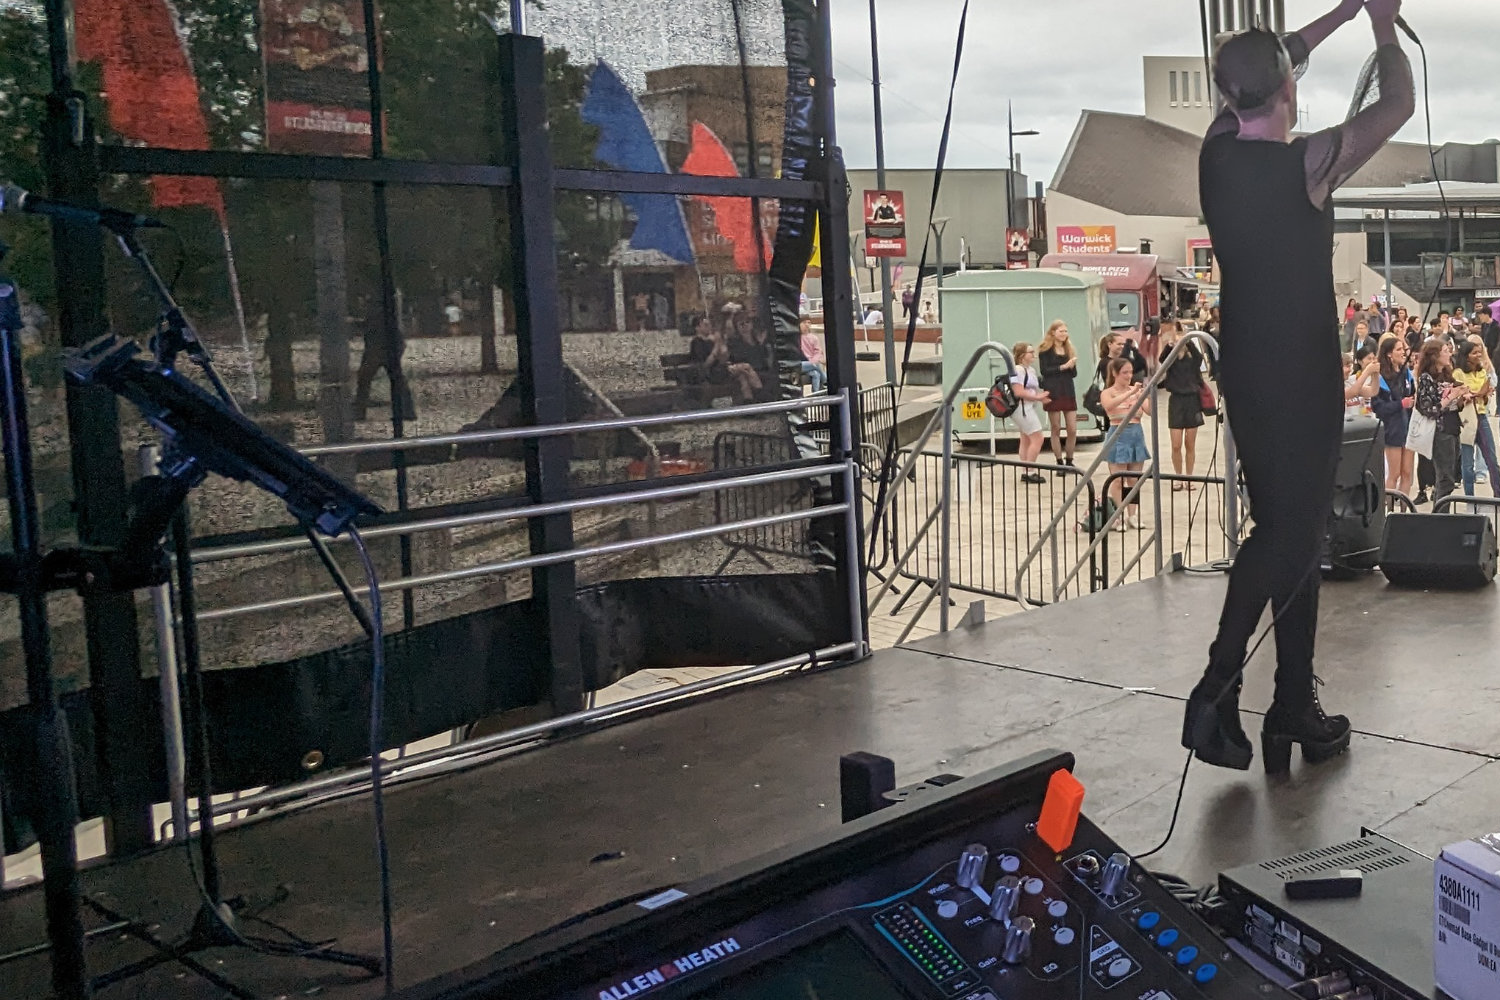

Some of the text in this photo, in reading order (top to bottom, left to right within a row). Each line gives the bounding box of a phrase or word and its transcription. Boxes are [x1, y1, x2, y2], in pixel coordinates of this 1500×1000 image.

[1061, 234, 1111, 243] Warwick
[1439, 874, 1480, 912] 4380A1111
[964, 915, 984, 927] Freq
[978, 956, 998, 968] Gain
[1043, 962, 1059, 974] EQ
